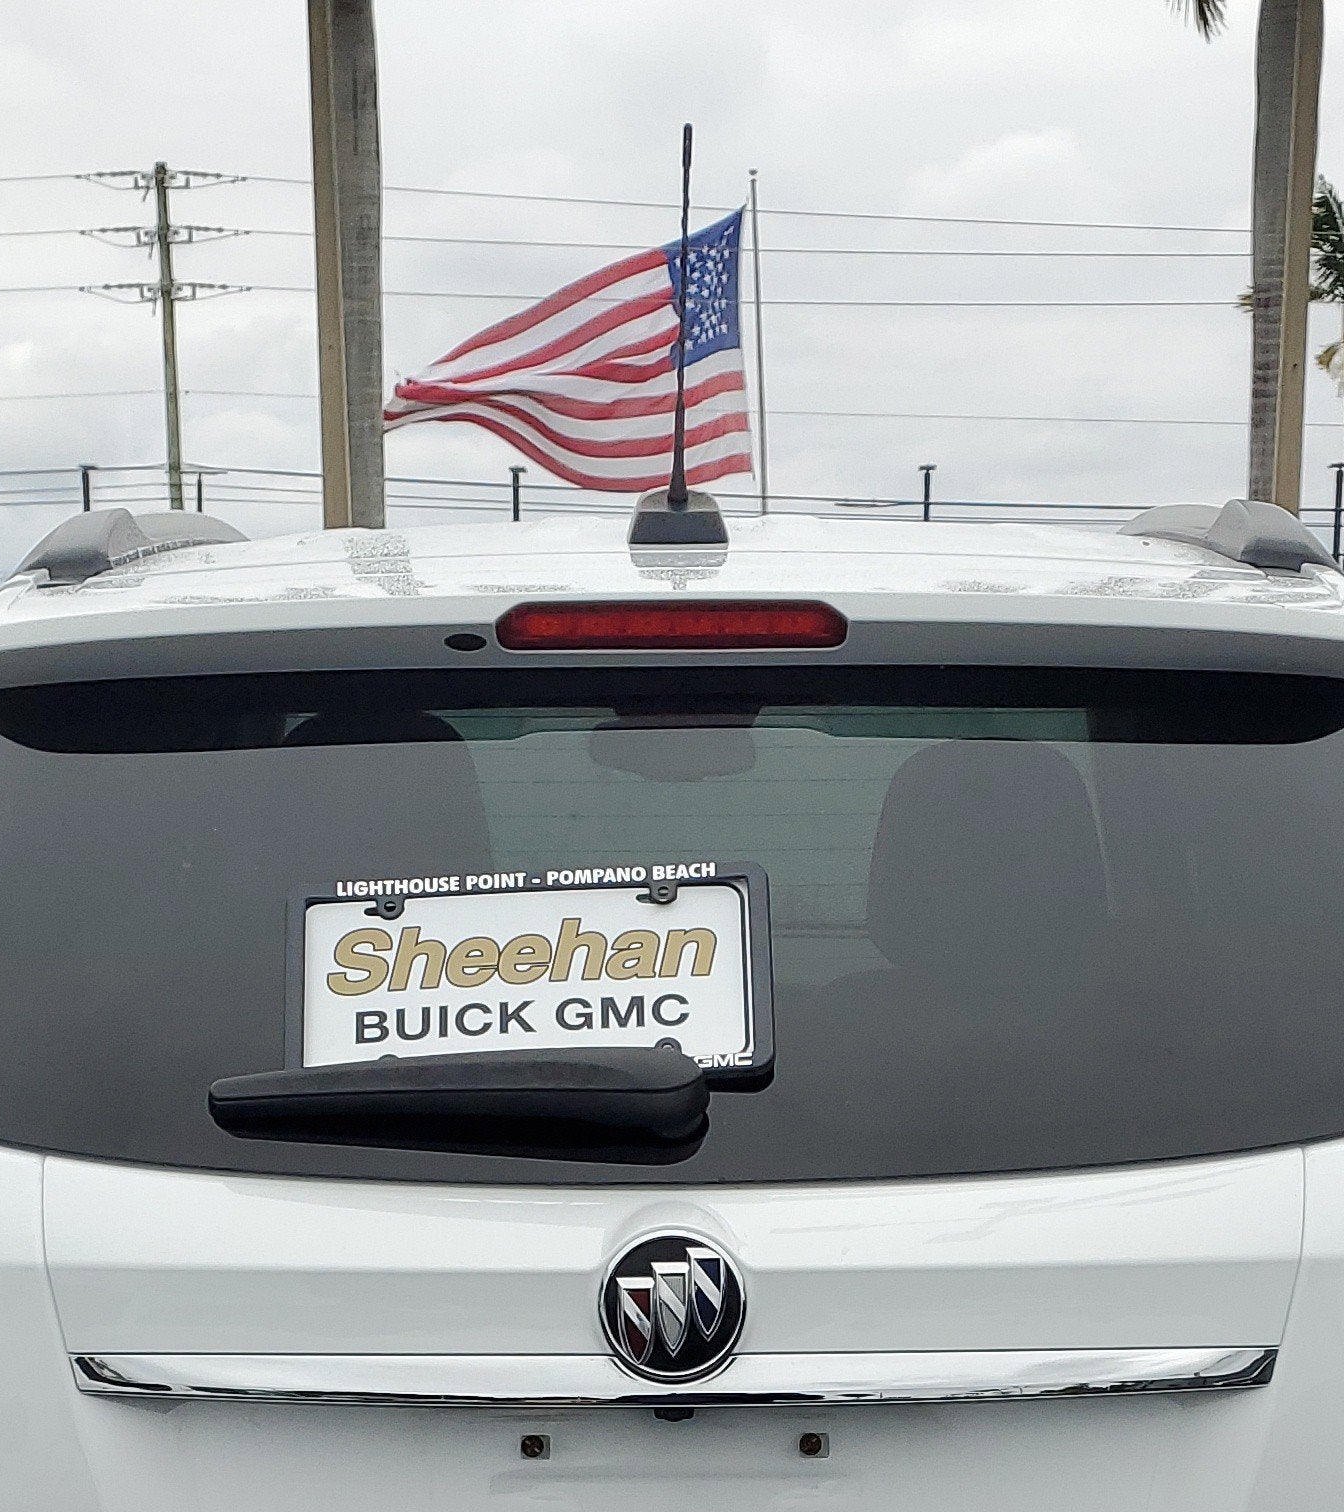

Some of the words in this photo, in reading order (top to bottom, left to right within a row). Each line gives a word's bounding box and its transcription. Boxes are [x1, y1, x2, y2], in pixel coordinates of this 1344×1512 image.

[336, 876, 460, 897] LIGHTHOUSE
[466, 872, 526, 890] POINT
[546, 866, 646, 886] POMPANO
[652, 862, 716, 881] BEACH
[327, 918, 717, 996] Sheehan
[355, 999, 537, 1045] BUICK
[555, 993, 690, 1030] GMC
[693, 1052, 753, 1069] GMC
